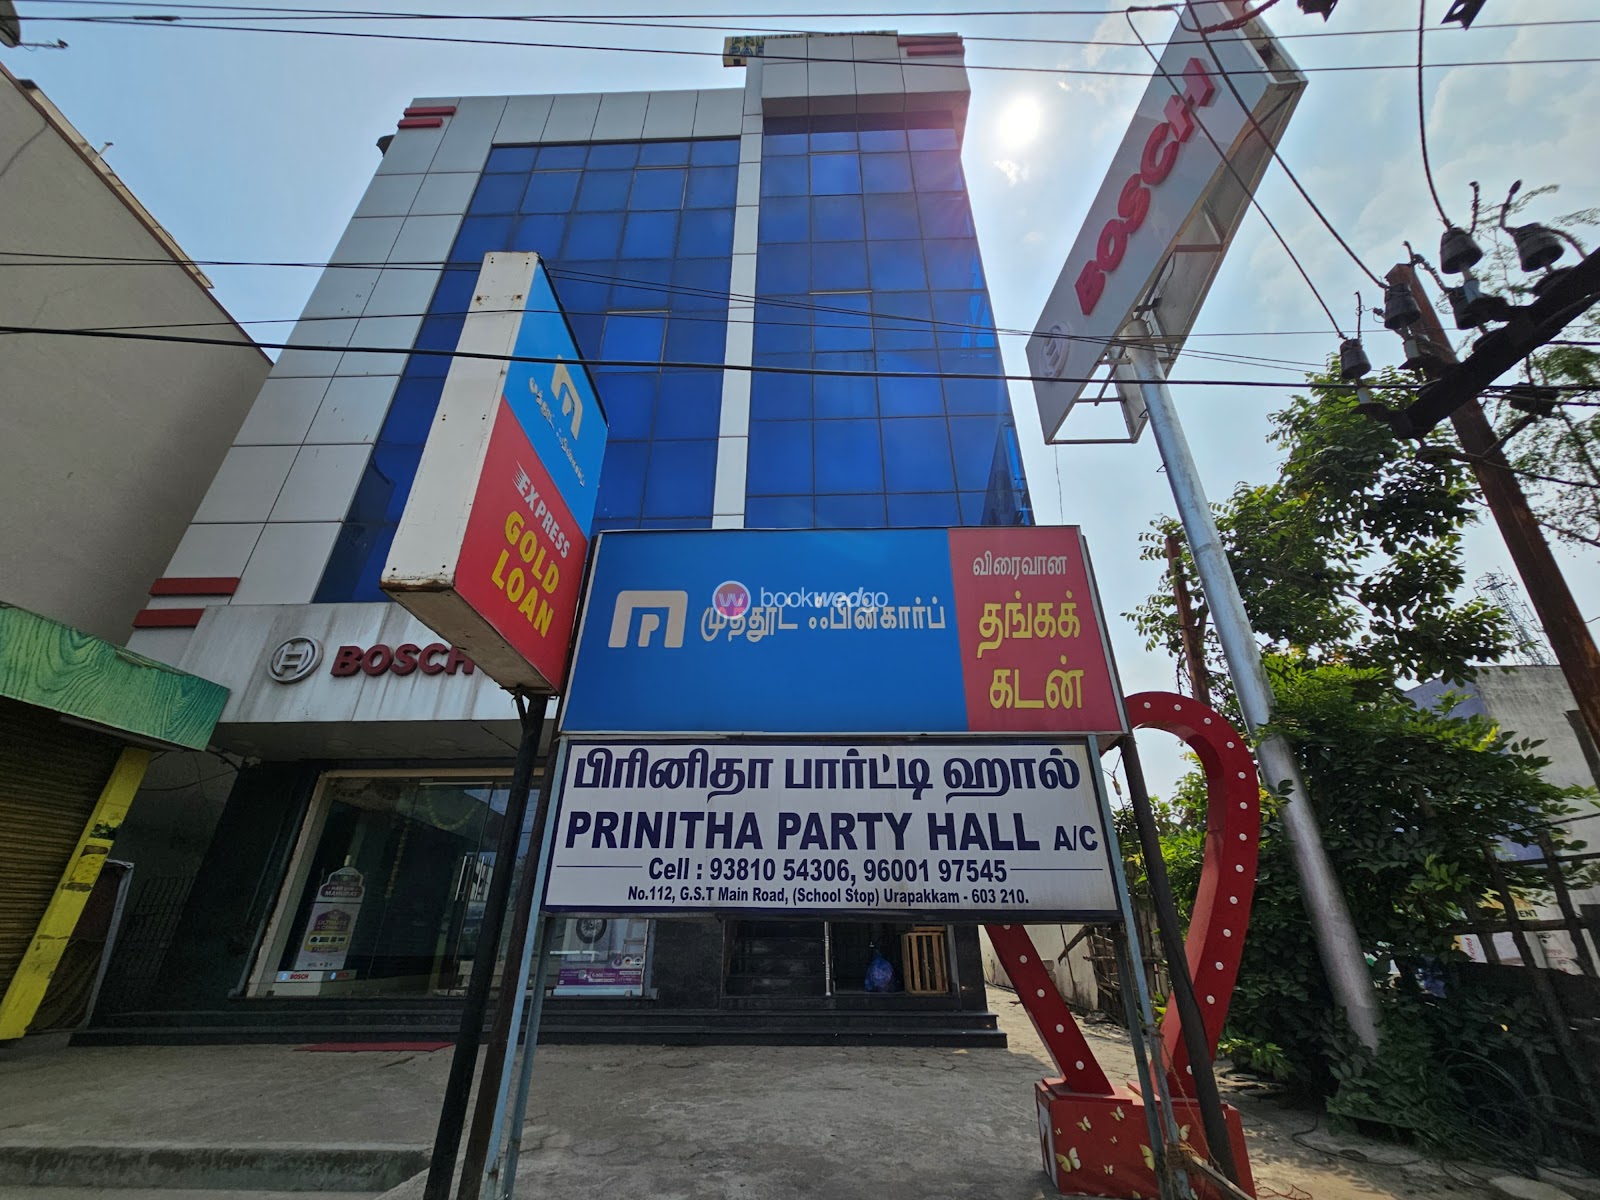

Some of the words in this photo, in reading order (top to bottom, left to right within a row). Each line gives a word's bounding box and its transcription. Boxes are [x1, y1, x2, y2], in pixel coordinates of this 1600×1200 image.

[1075, 57, 1216, 316] BOSCH
[512, 460, 570, 558] EXPRESS
[505, 511, 559, 594] GOLD
[973, 551, 1067, 580] விரைவான
[491, 548, 554, 637] LOAN
[977, 590, 1080, 658] தங்கக்
[330, 643, 476, 677] BOSCH
[989, 654, 1084, 709] கடன்
[573, 747, 773, 804] பிரினிதா
[784, 748, 933, 800] பார்ட்டி
[943, 748, 1080, 804] ஹால்
[565, 811, 763, 849] PRINITHA
[777, 812, 912, 850] PARTY
[927, 812, 1040, 850] HALL
[1054, 825, 1098, 851] A/C
[628, 886, 676, 903] No.112,
[680, 886, 714, 901] G.S.T
[718, 887, 748, 901] Main
[752, 887, 789, 904] Road,
[792, 887, 841, 905] (School
[845, 888, 879, 906] Stop)
[883, 889, 959, 906] Urapakkam
[971, 889, 996, 904] 603
[1000, 889, 1029, 904] 210.
[649, 857, 690, 880] Cell
[709, 858, 776, 881] 93810
[782, 859, 856, 887] 54306,
[863, 859, 930, 882] 96001
[938, 859, 1007, 883] 97545
